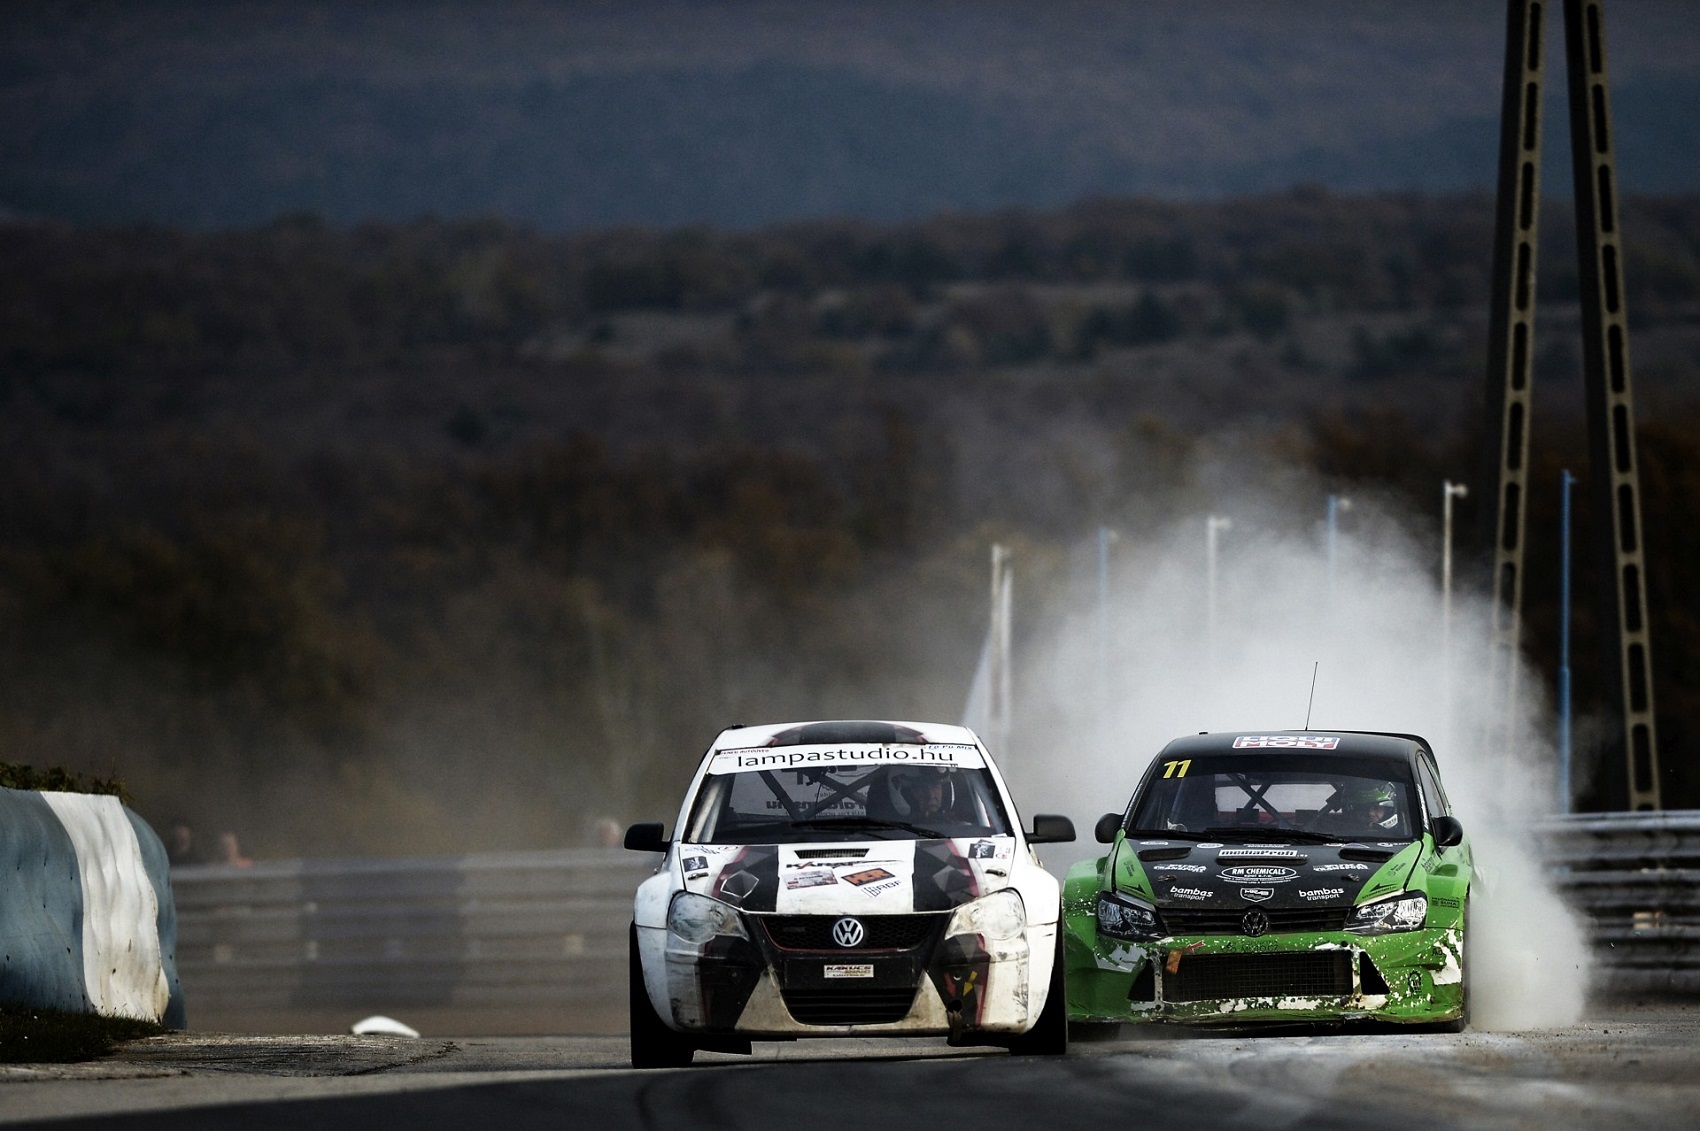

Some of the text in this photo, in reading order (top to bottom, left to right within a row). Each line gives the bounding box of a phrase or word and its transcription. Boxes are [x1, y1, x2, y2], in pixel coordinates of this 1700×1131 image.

[1240, 741, 1333, 749] MOLY
[737, 748, 953, 767] lampastudio.hu
[1163, 760, 1191, 778] 11
[1170, 886, 1214, 898] bambas
[1173, 893, 1205, 901] transport
[1298, 887, 1344, 898] bambas
[1307, 893, 1340, 901] transport
[833, 918, 864, 947] VW
